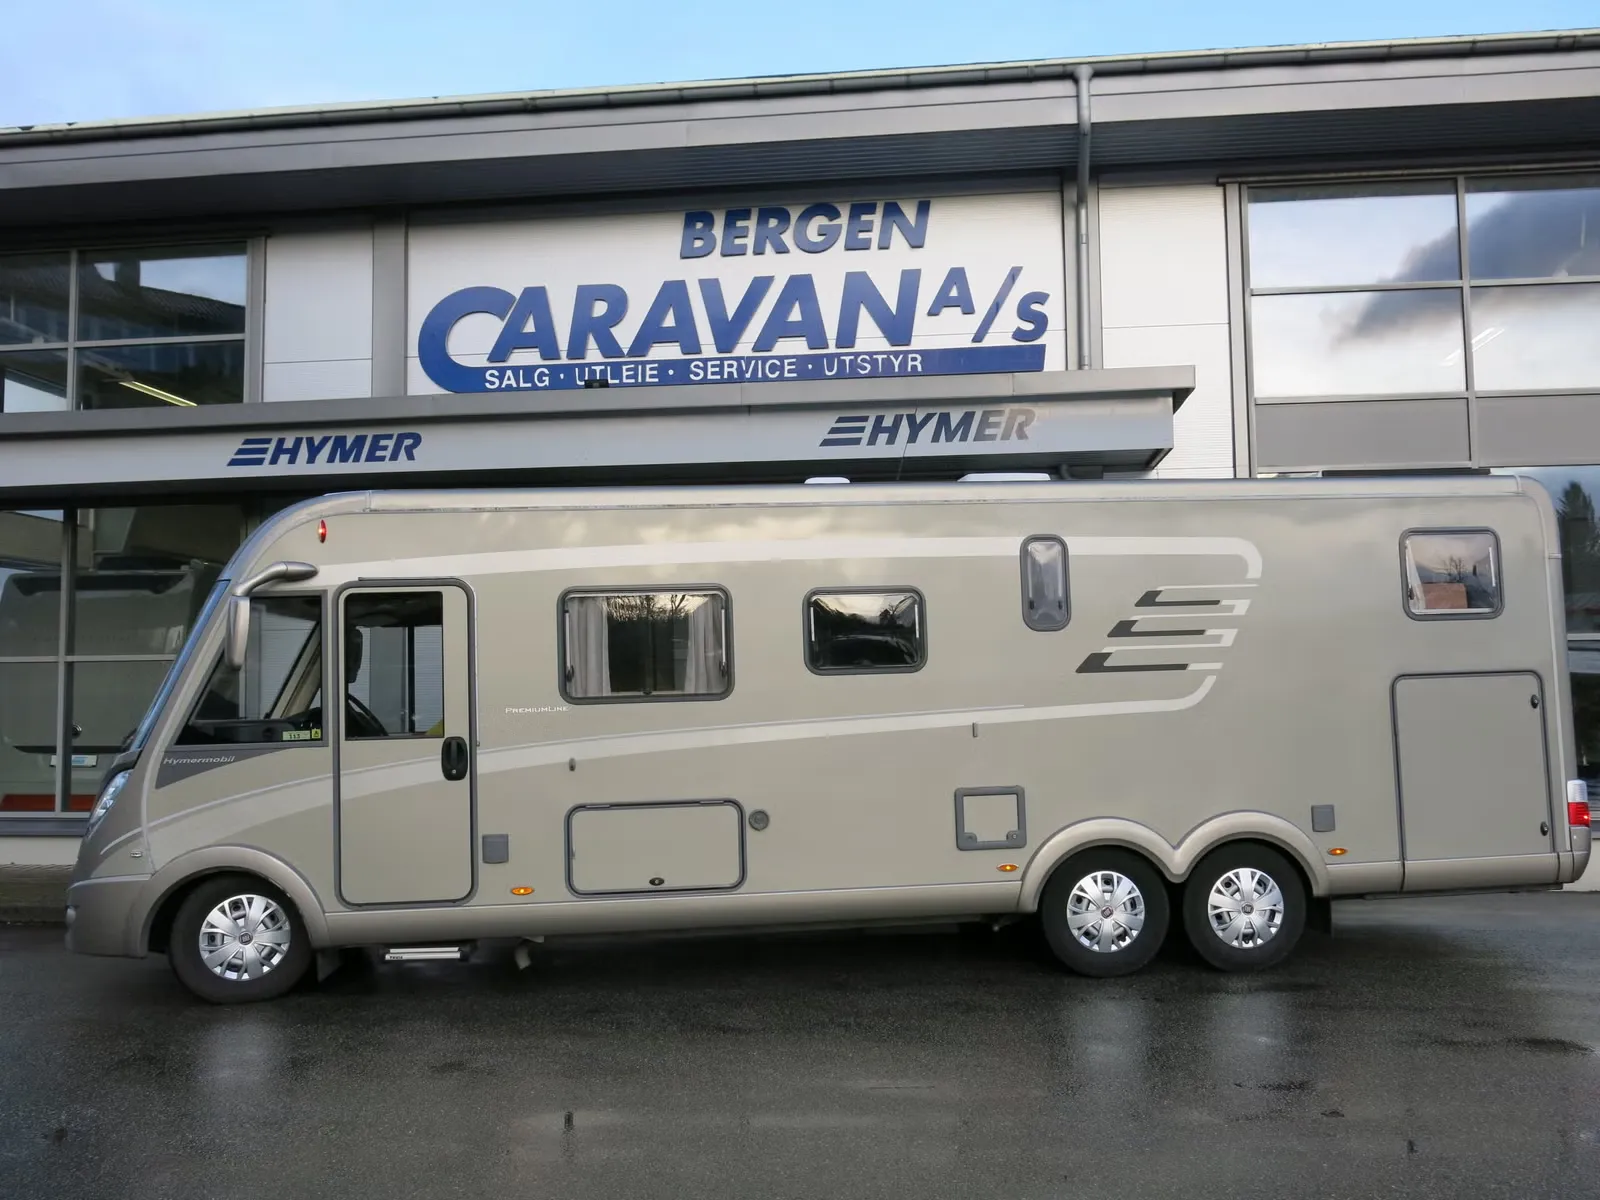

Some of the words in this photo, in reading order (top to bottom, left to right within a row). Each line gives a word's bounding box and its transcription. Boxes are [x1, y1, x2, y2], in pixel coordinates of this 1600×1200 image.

[680, 199, 931, 259] BERGEN
[418, 268, 922, 393] CARAVAN
[927, 266, 1050, 343] A/S
[484, 367, 550, 389] SALG
[575, 363, 659, 387] UTLEIE
[689, 358, 798, 381] SERVICE
[824, 353, 923, 376] UTSTYR
[866, 408, 1036, 446] HYMER
[268, 432, 422, 465] HYMER
[163, 755, 236, 765] Hymermobil
